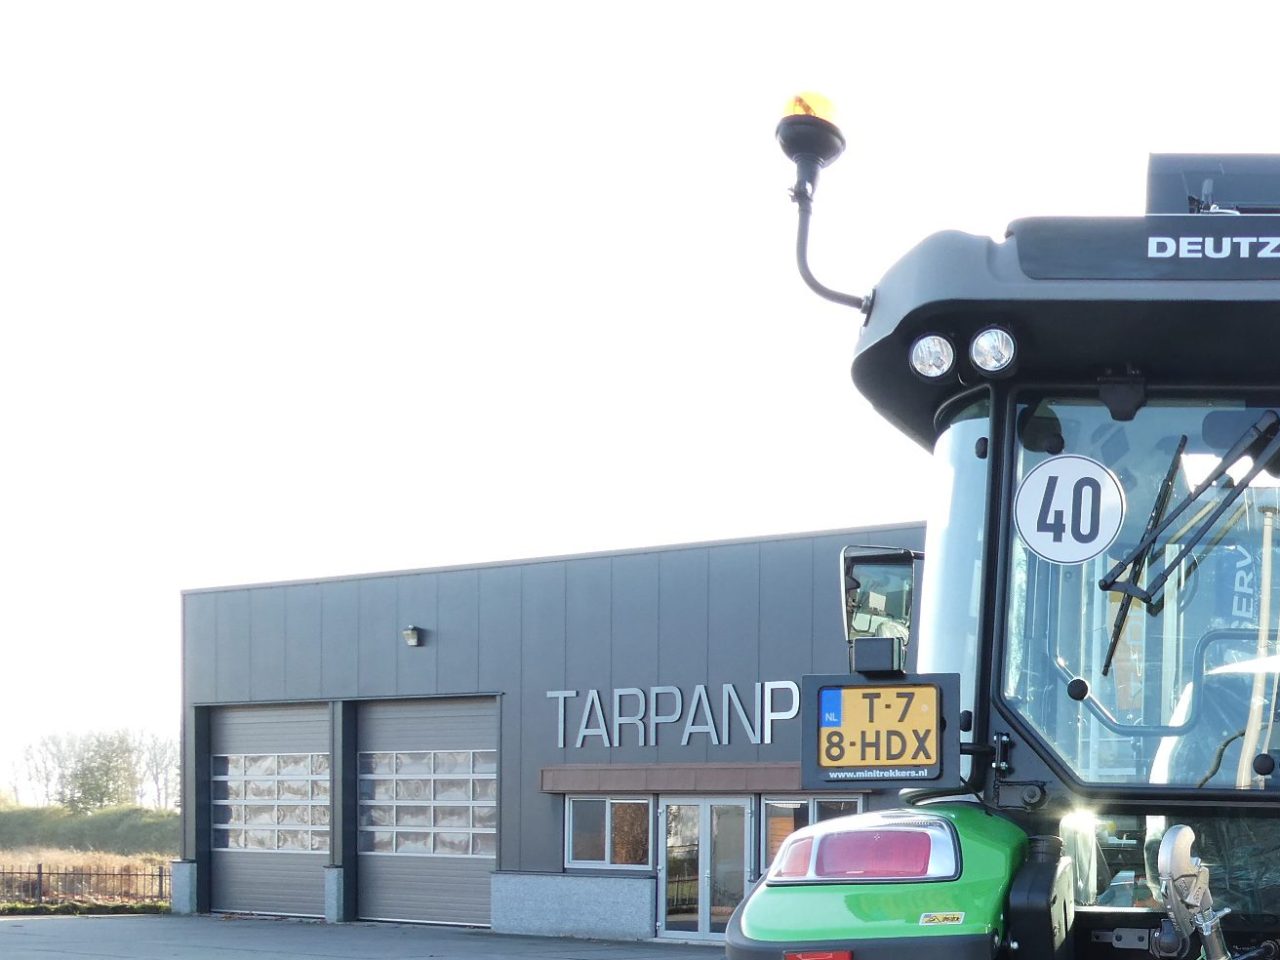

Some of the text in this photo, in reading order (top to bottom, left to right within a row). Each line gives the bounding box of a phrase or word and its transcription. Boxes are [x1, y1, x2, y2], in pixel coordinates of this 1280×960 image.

[1036, 475, 1101, 544] 40
[825, 712, 838, 721] NL
[862, 692, 915, 723] T-7
[825, 729, 931, 761] 8-HDX
[829, 769, 928, 778] www.minitrekkers.nl
